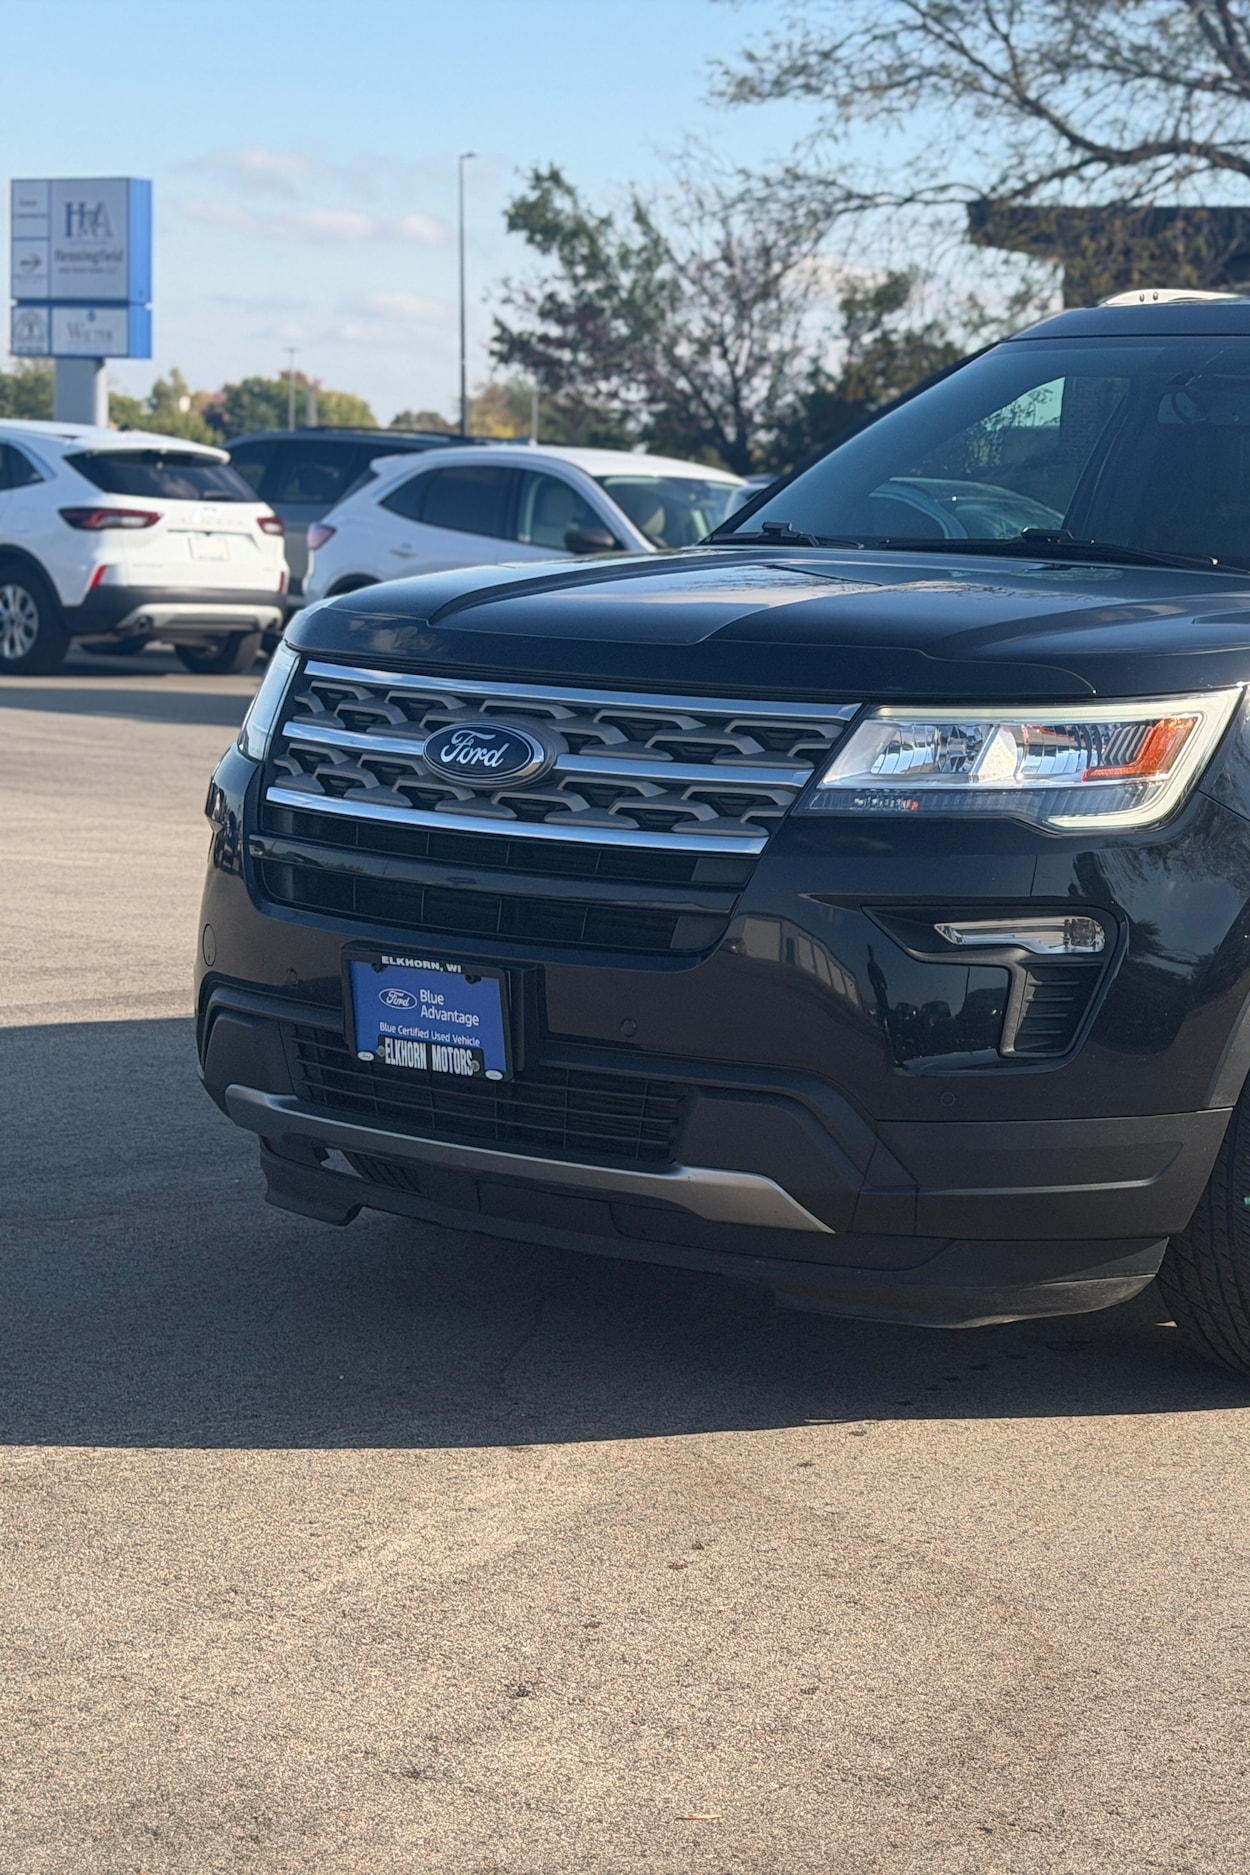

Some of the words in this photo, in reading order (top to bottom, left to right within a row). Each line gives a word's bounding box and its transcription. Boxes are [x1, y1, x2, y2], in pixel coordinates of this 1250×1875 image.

[440, 729, 510, 767] Ford
[381, 955, 444, 973] ELKHORN,
[445, 963, 462, 974] WI
[419, 988, 445, 1006] Blue
[420, 1004, 480, 1028] Advantage
[379, 1022, 397, 1034] Blue
[397, 1025, 430, 1039] Certified
[430, 1030, 451, 1043] Used
[451, 1034, 481, 1048] Vehicle
[384, 1037, 428, 1071] ELKHORN
[431, 1044, 475, 1077] MOTORS
